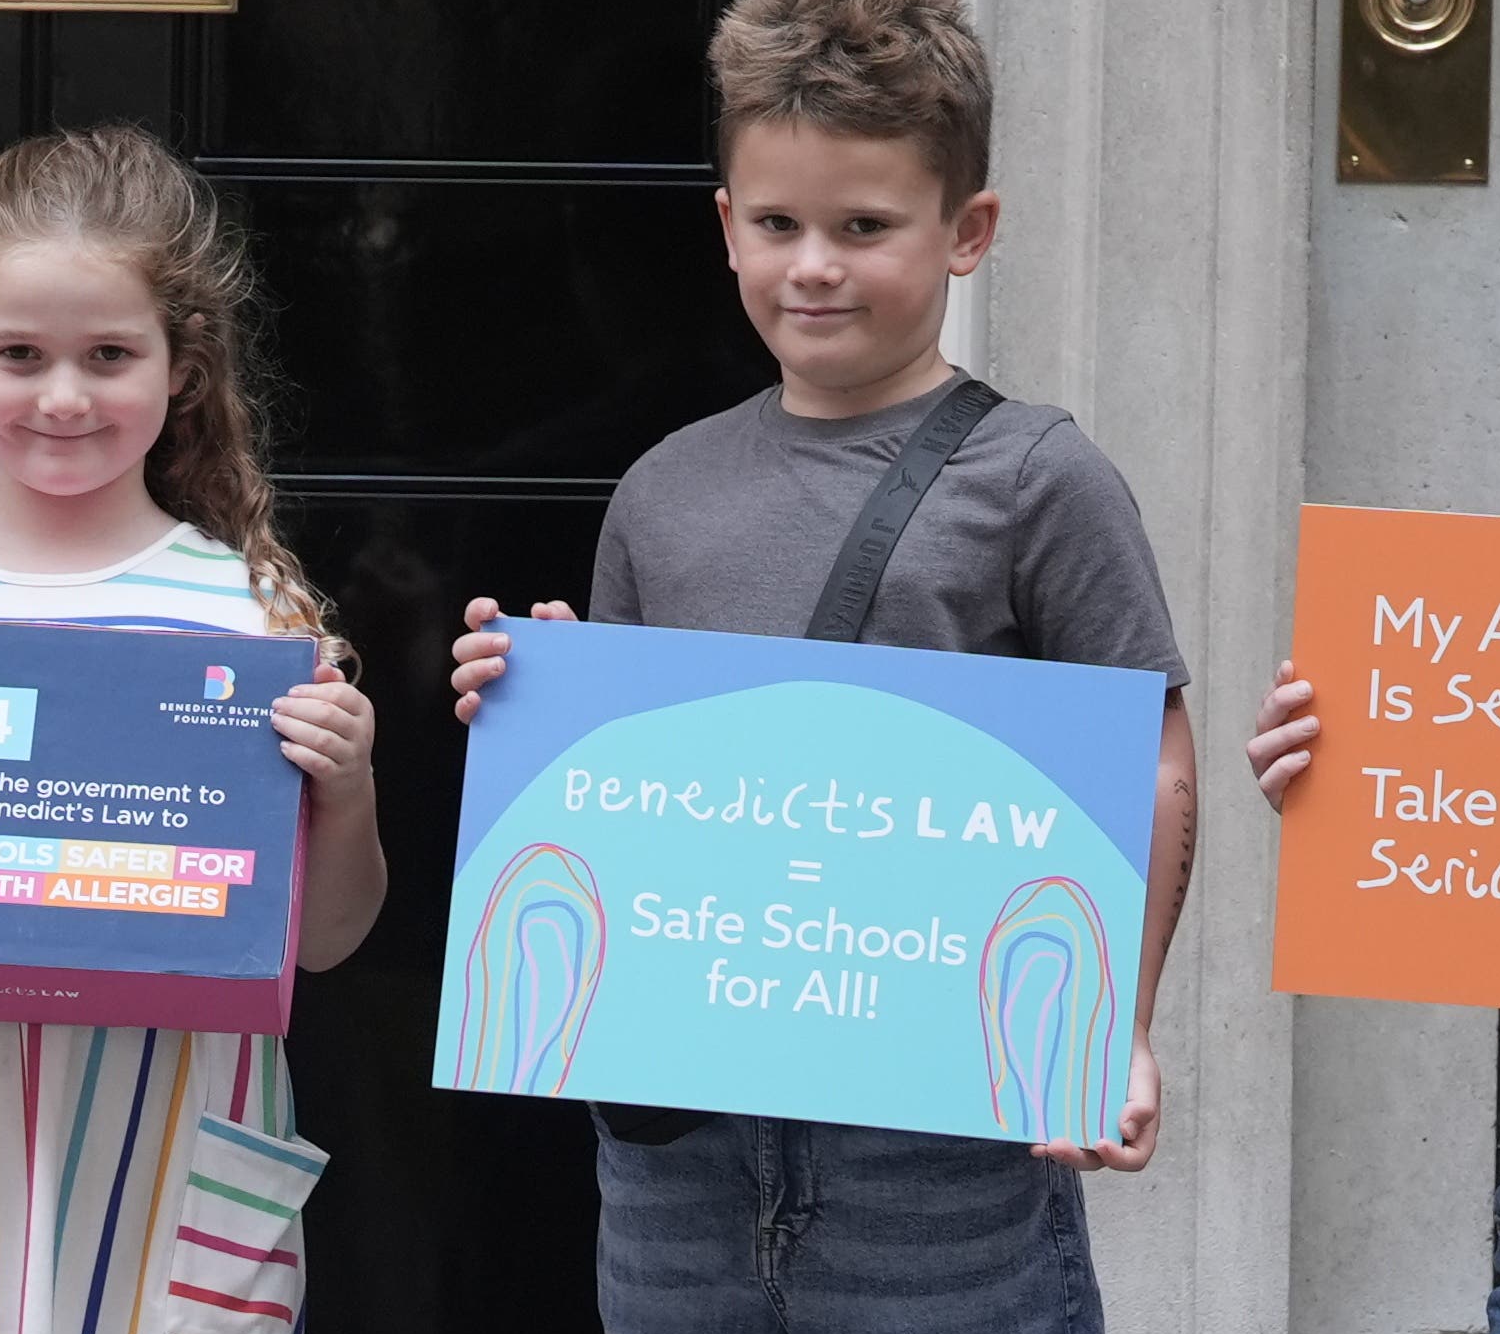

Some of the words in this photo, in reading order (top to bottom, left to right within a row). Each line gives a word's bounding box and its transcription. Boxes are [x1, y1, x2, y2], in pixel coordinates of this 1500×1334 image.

[1372, 593, 1462, 665] My
[159, 702, 224, 714] BENEDICT
[1369, 668, 1414, 722] Is
[173, 714, 260, 728] FOUNDATION
[36, 777, 192, 803] government
[199, 784, 226, 805] to
[1361, 766, 1497, 828] Take
[102, 804, 155, 827] Law
[161, 808, 189, 828] to
[563, 768, 895, 839] Benedict's
[916, 798, 1058, 849] LAW
[66, 845, 170, 873] SAFER
[179, 851, 246, 878] FOR
[48, 878, 220, 910] ALLERGIES
[630, 892, 746, 944] Safe
[761, 903, 968, 965] Schools
[41, 989, 81, 999] LAW
[706, 959, 781, 1008] for
[792, 969, 880, 1019] All!
